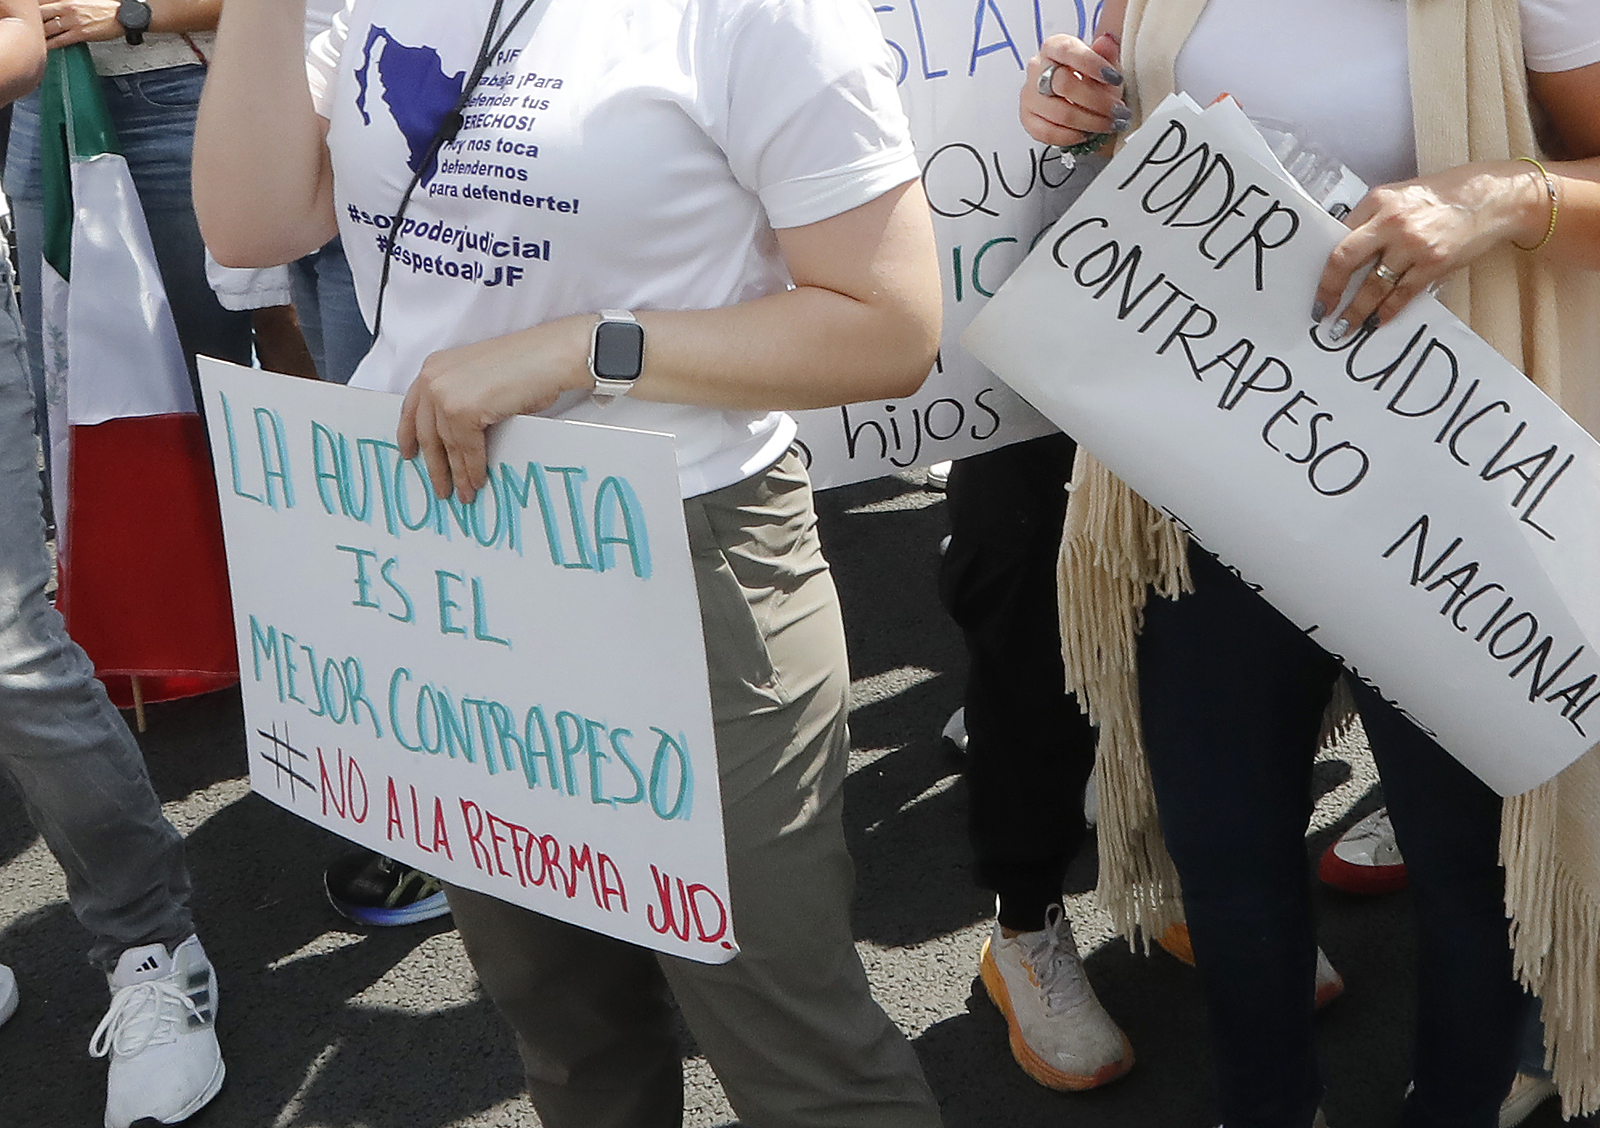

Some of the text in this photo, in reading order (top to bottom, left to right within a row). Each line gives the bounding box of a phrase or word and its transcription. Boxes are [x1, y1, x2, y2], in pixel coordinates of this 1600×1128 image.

[463, 113, 537, 132] ERECHOS!
[521, 94, 551, 111] tus
[441, 159, 529, 182] defendernos
[466, 138, 492, 152] nos
[496, 136, 539, 158] toca
[429, 182, 580, 215] para defenderte!
[1117, 119, 1300, 293] PODER
[1051, 216, 1371, 497] CONTRAPESO
[843, 386, 1000, 468] hijos
[220, 390, 653, 581] LA AUTONOMIA
[434, 569, 513, 652] EL
[247, 613, 695, 823] MEJOR CONTRAPESO
[256, 719, 736, 952] #NO A LA REFORMA JUD.
